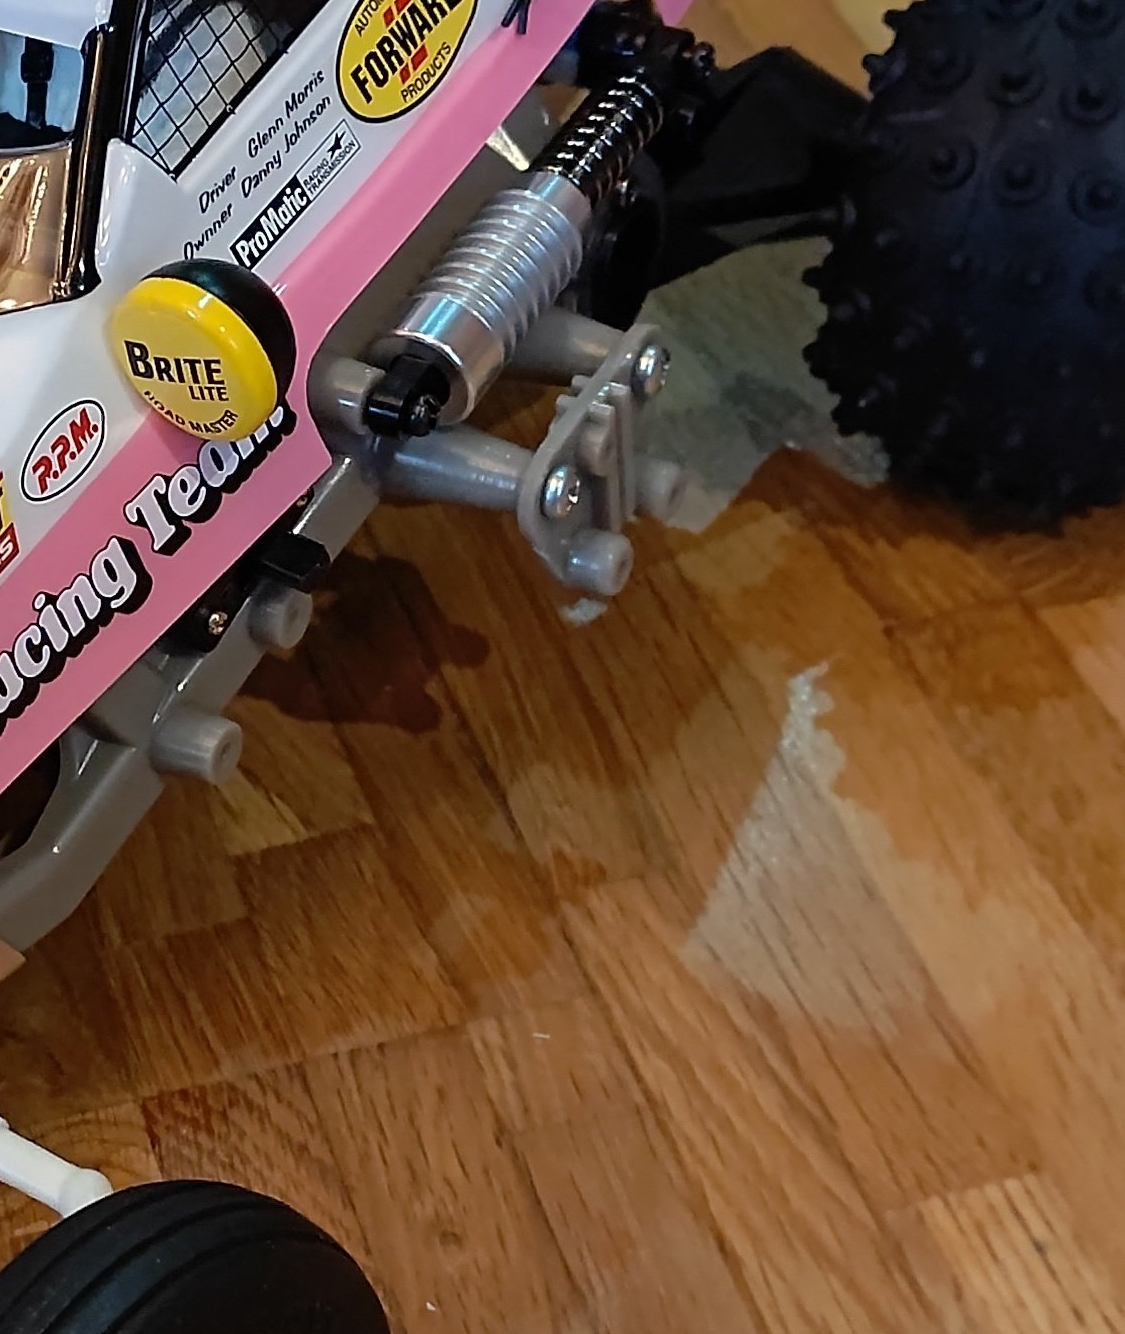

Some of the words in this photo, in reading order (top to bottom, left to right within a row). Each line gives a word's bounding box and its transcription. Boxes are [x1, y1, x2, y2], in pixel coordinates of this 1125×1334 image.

[400, 41, 451, 103] PRODUCTS
[198, 166, 237, 214] Driver
[247, 116, 284, 158] Glenn
[283, 70, 325, 119] Morris
[241, 150, 282, 198] Danny
[284, 96, 331, 153] Johnson
[307, 139, 356, 195] TRANSMISSION
[302, 157, 329, 188] RACING
[234, 187, 308, 268] ProMatic
[123, 340, 226, 385] BRITE
[187, 408, 239, 434] MASTER
[188, 385, 230, 402] LITE
